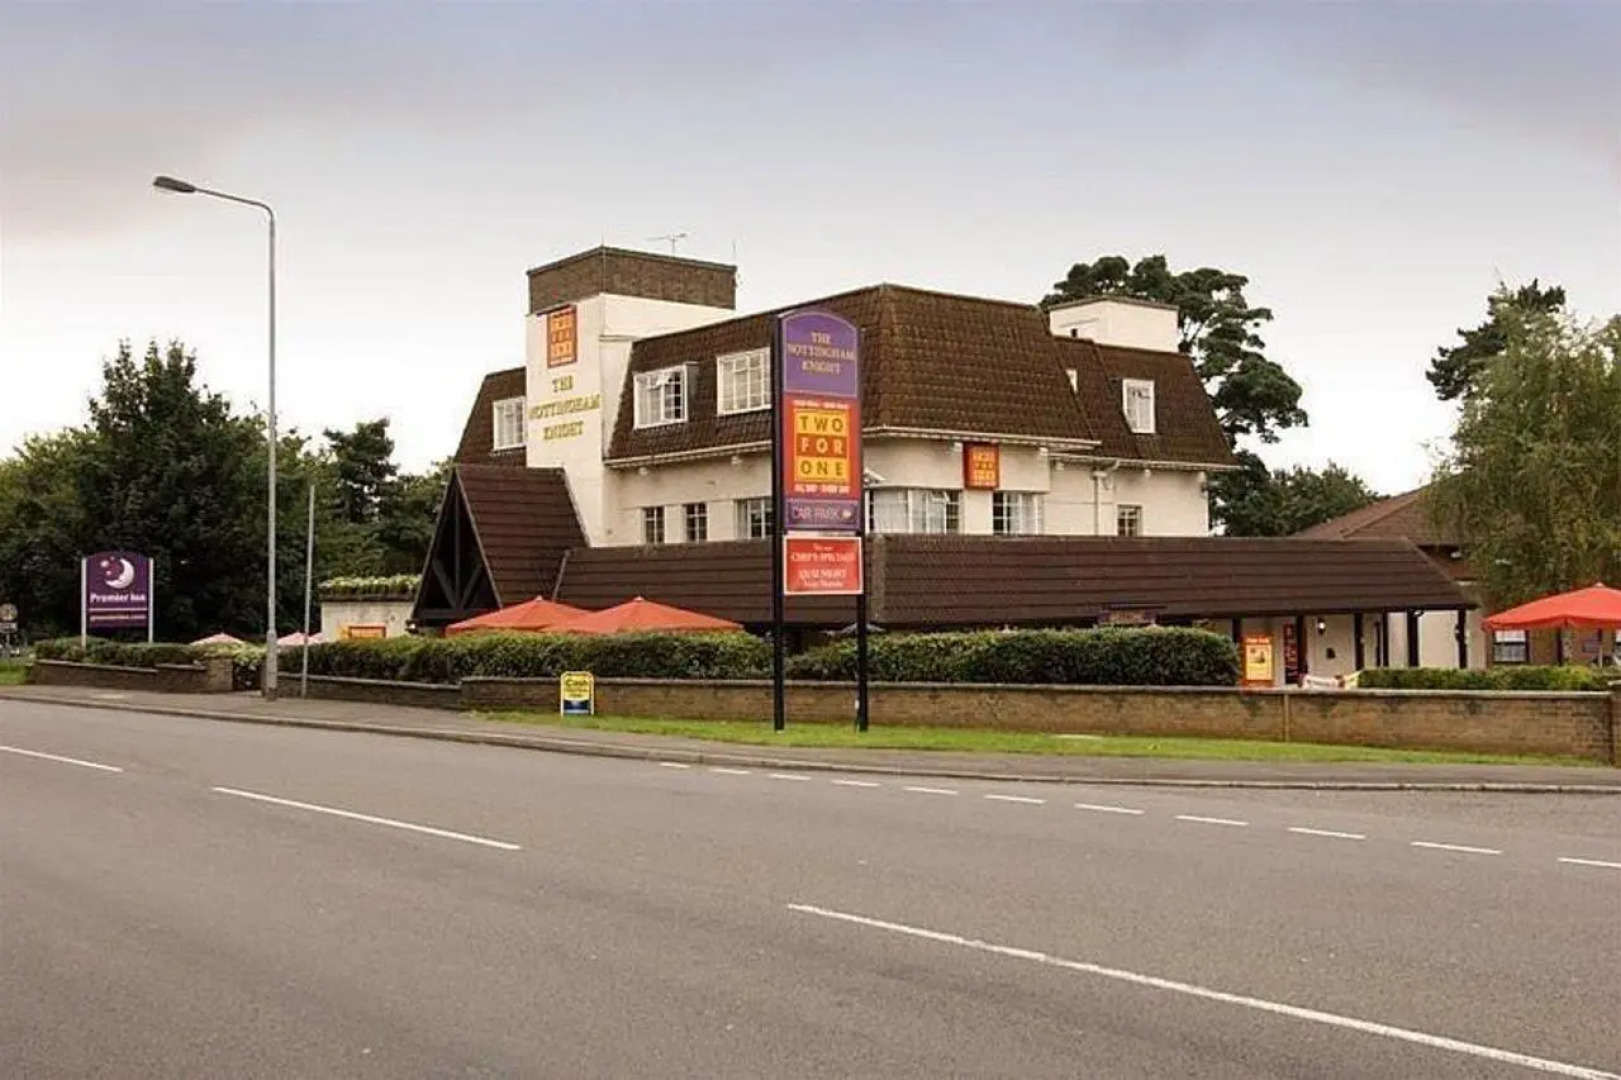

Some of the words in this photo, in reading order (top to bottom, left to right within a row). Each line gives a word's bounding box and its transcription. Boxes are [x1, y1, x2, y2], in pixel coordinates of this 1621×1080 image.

[811, 331, 831, 344] THE
[787, 344, 857, 361] NOTTINGHAM
[802, 361, 840, 375] KNIGHT
[552, 375, 574, 393] THE
[528, 394, 601, 419] NOTTINGHAM
[543, 420, 584, 440] KNIGHT
[799, 416, 843, 432] TWO
[801, 437, 843, 455] FOR
[801, 460, 843, 476] ONE
[90, 592, 129, 603] Premier
[130, 592, 147, 602] Inn
